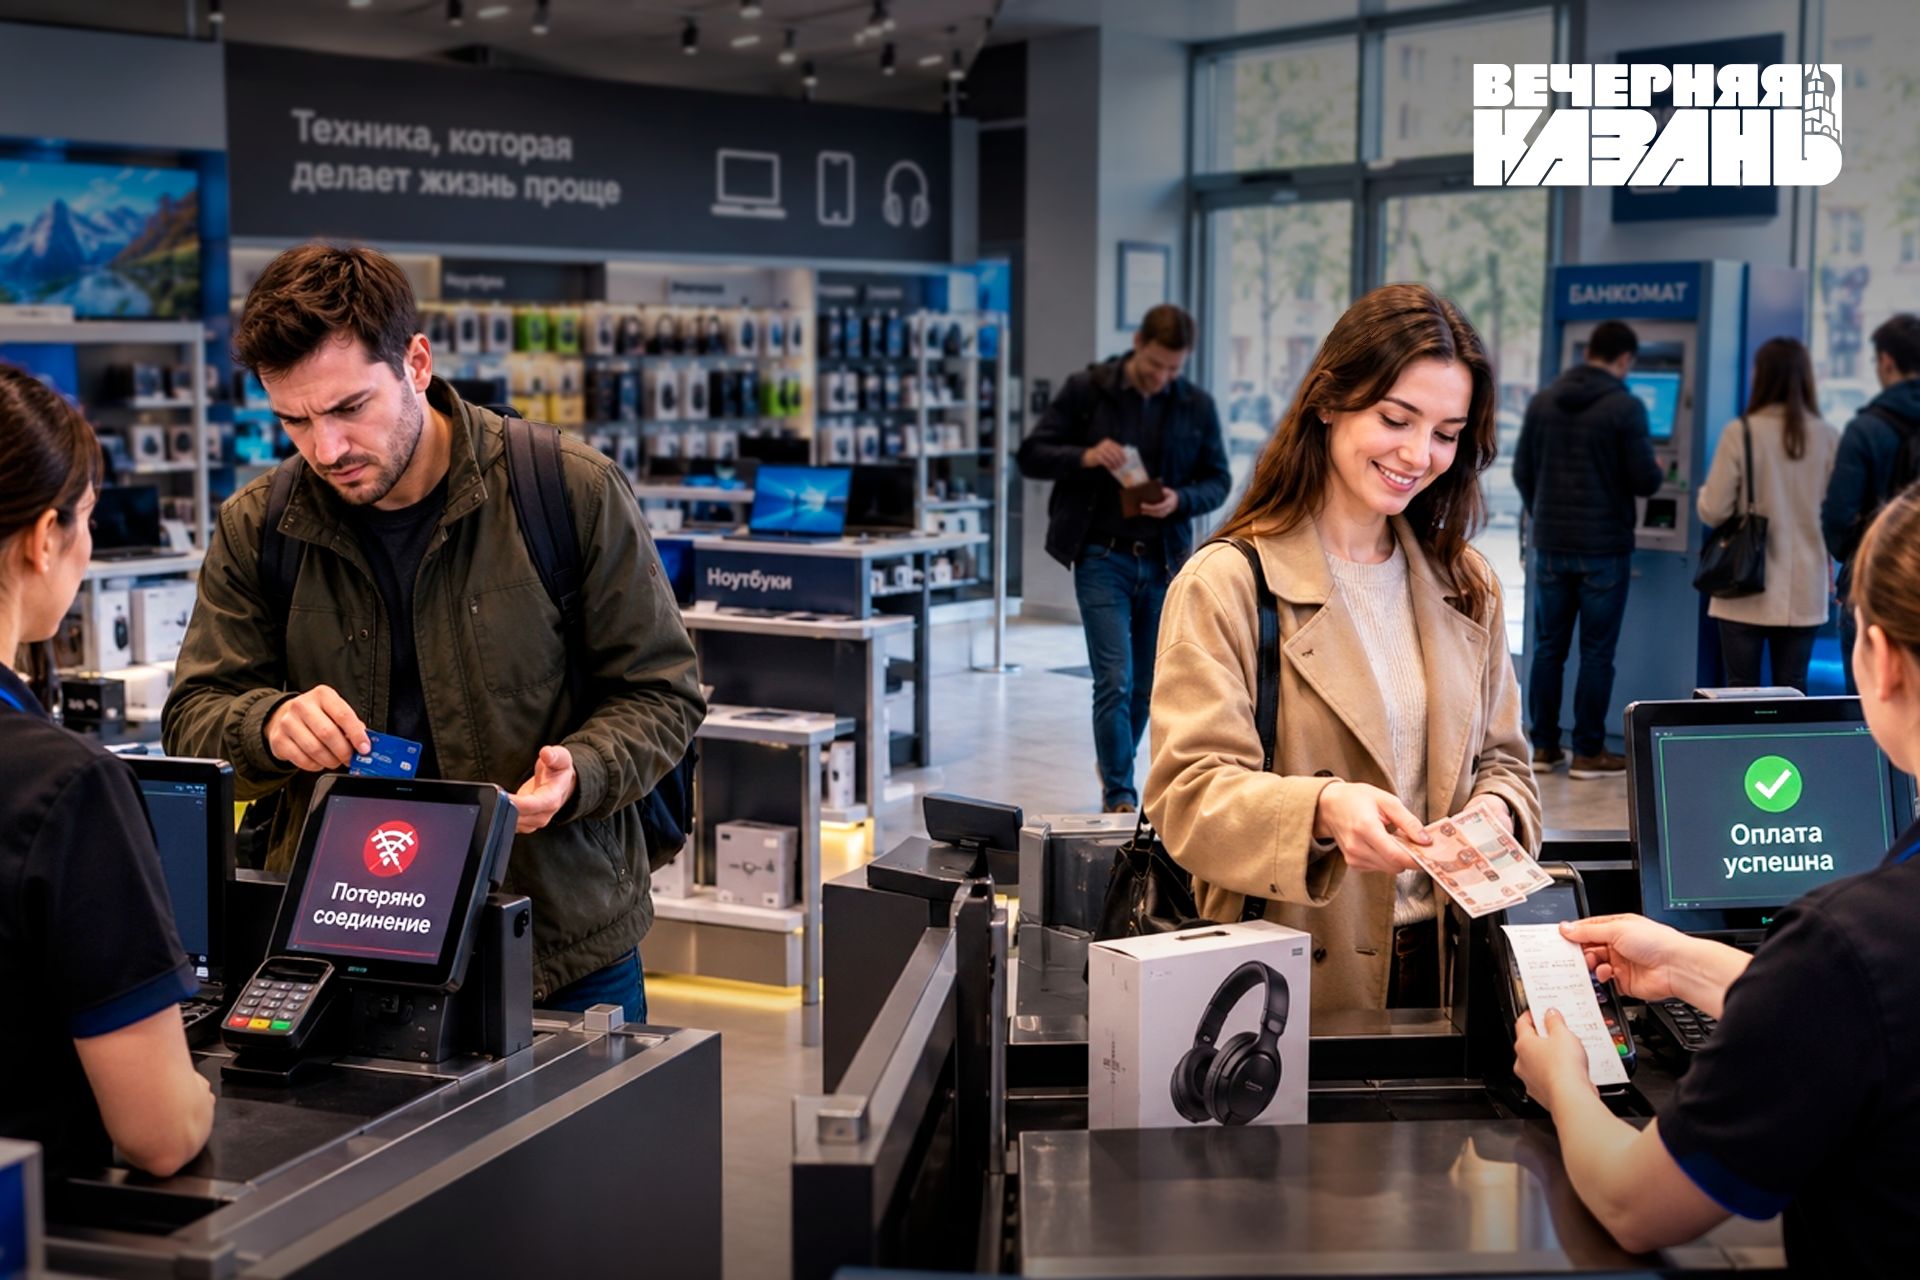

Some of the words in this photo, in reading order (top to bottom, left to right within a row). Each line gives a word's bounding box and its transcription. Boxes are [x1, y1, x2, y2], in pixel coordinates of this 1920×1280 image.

[291, 109, 440, 156] Техника,
[449, 128, 573, 164] которая
[291, 161, 411, 195] делает
[419, 168, 517, 198] жизнь
[524, 176, 621, 207] проще
[1569, 282, 1688, 304] БАНКОМАТ
[707, 567, 792, 592] Ноутбуки
[1731, 823, 1823, 845] Оплата
[1723, 854, 1834, 879] успешна
[331, 882, 426, 909] Потеряно
[313, 909, 431, 934] соединение
